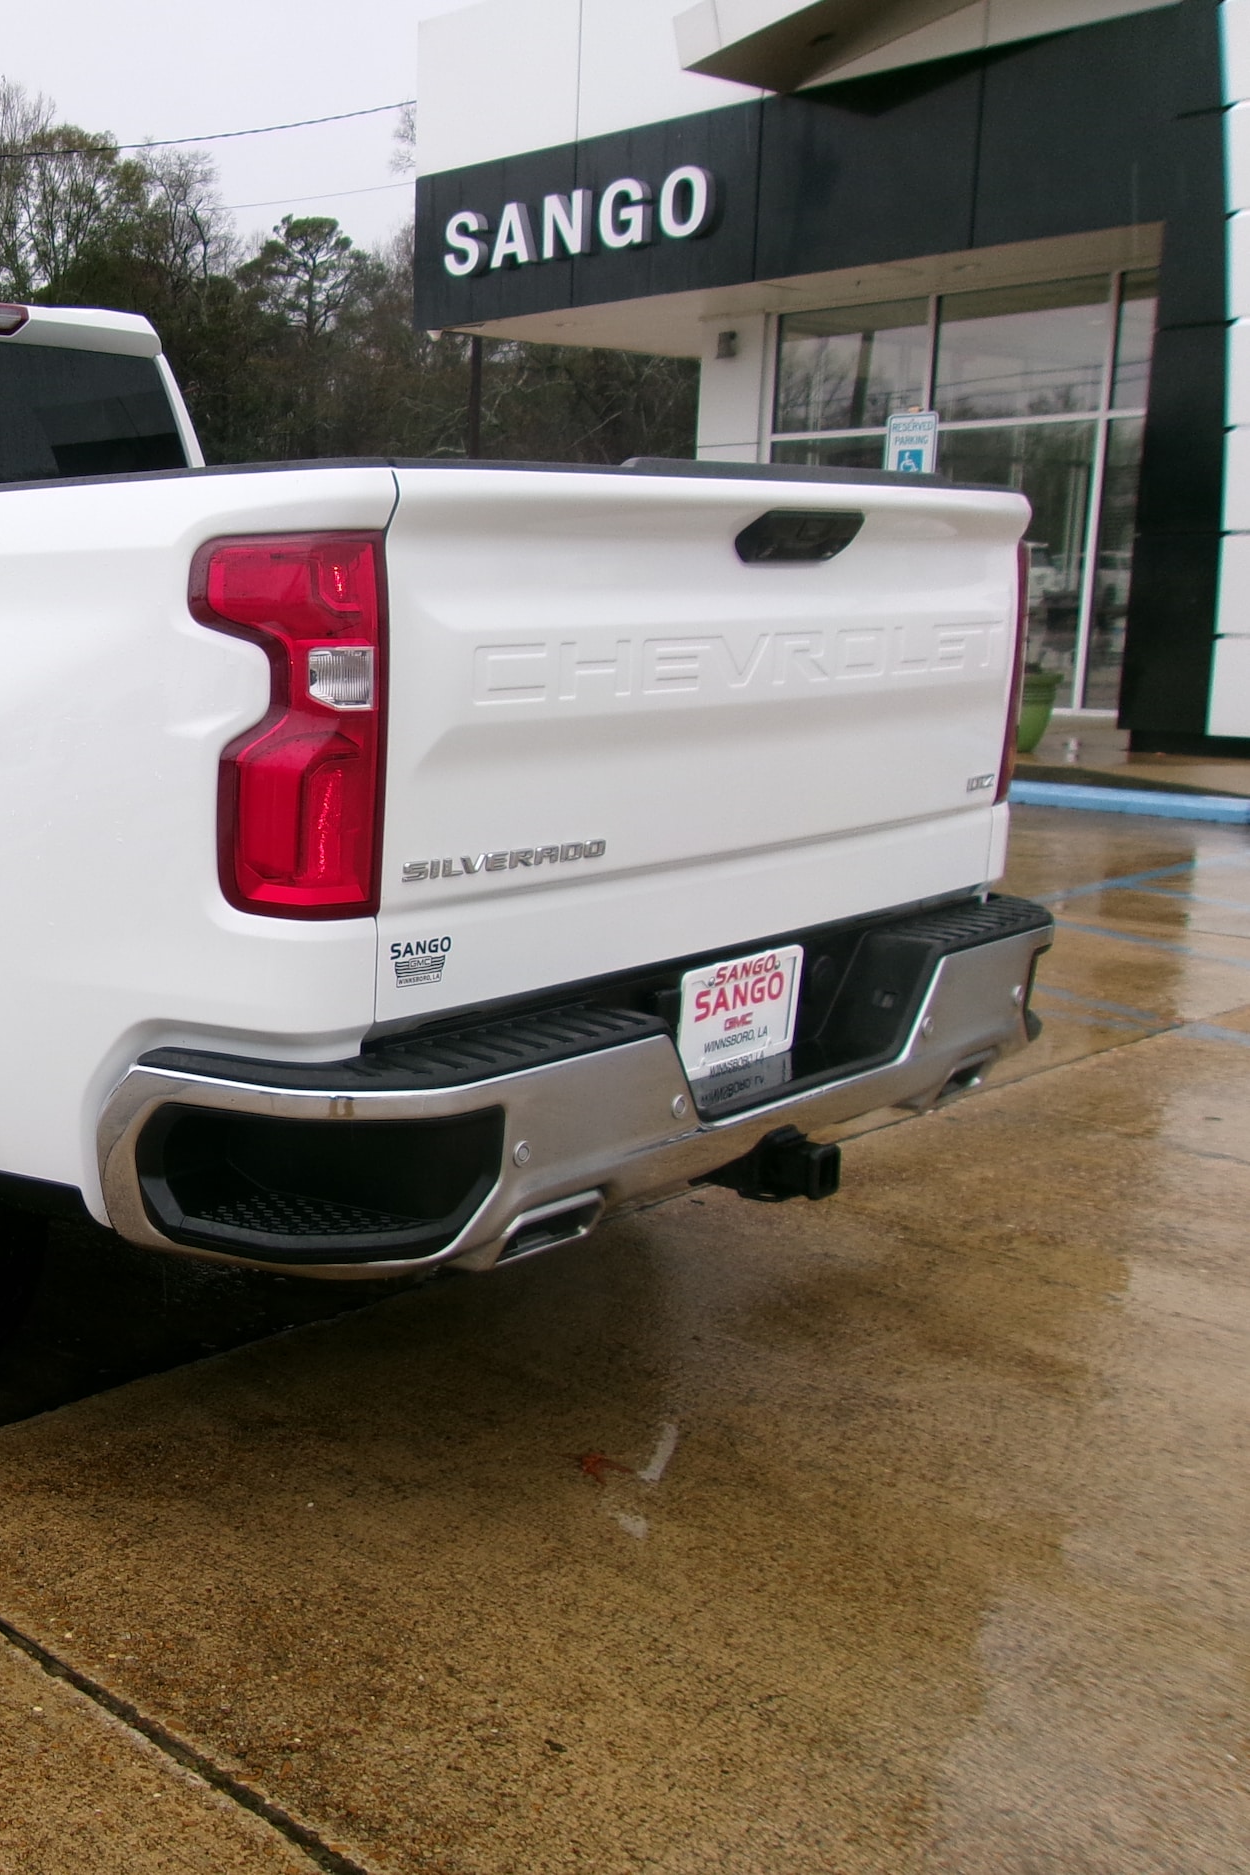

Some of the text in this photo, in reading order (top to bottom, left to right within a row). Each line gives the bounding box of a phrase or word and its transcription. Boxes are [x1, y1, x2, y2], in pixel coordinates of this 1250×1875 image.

[444, 165, 714, 277] SANGO
[892, 421, 934, 433] RESERVED
[894, 435, 929, 446] PARKING
[473, 620, 1004, 706] CHEVROLET
[402, 838, 606, 883] SILVERADO
[390, 936, 452, 960] SANGO
[410, 958, 431, 968] GMC
[714, 953, 776, 987] SANGO
[433, 973, 441, 981] LA
[694, 971, 785, 1023] SANGO
[724, 1012, 753, 1031] GMC
[704, 1025, 768, 1054] WINNSBORO, LA
